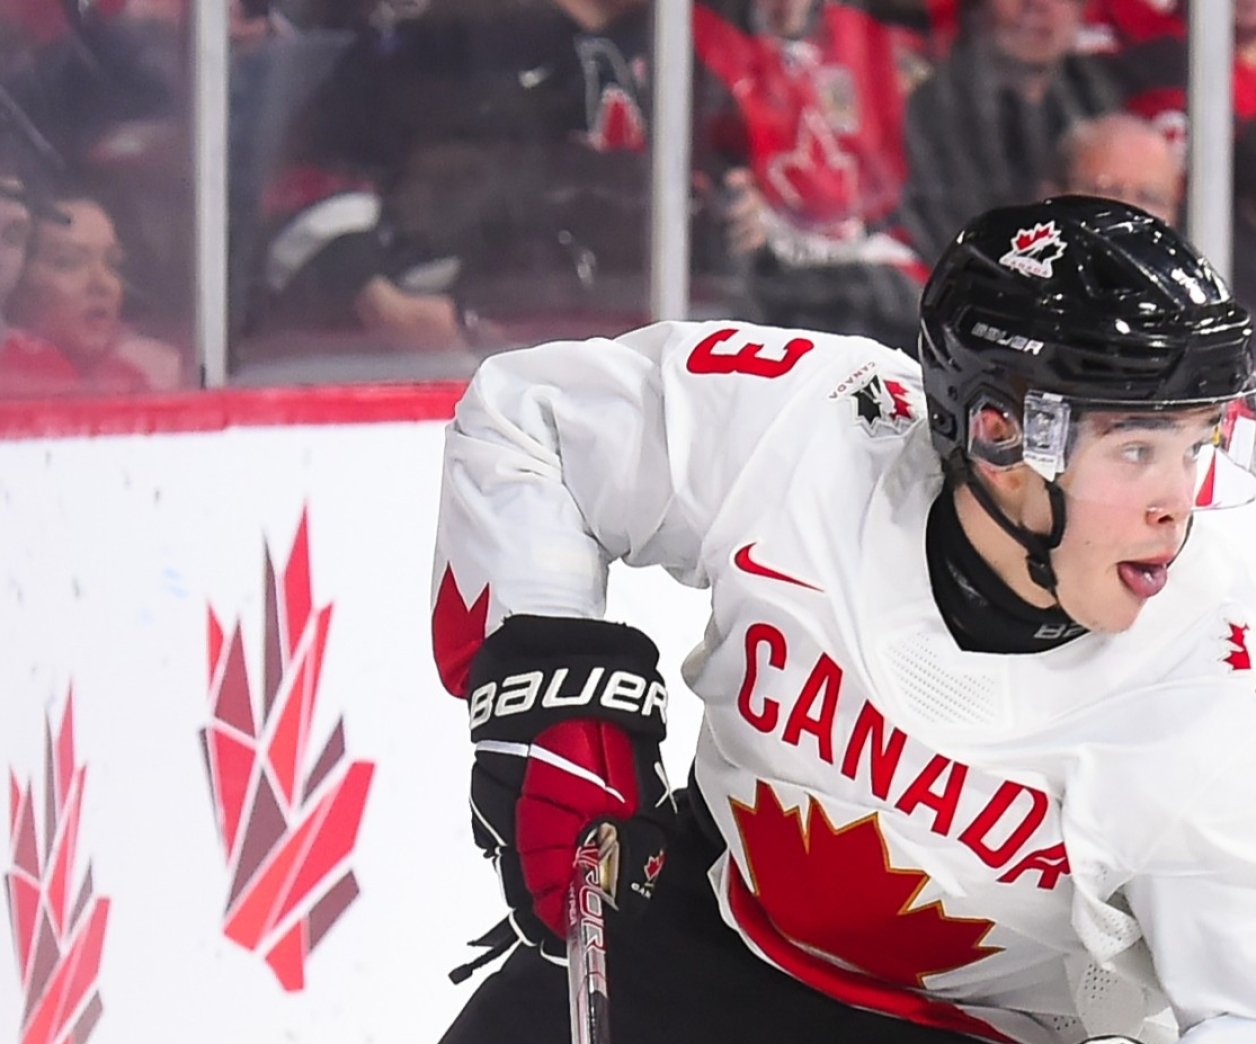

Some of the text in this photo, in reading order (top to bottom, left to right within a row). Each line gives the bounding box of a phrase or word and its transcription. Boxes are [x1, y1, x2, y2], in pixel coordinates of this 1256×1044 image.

[686, 328, 815, 379] 3
[469, 667, 669, 730] BAUER
[738, 622, 1071, 890] CANADA
